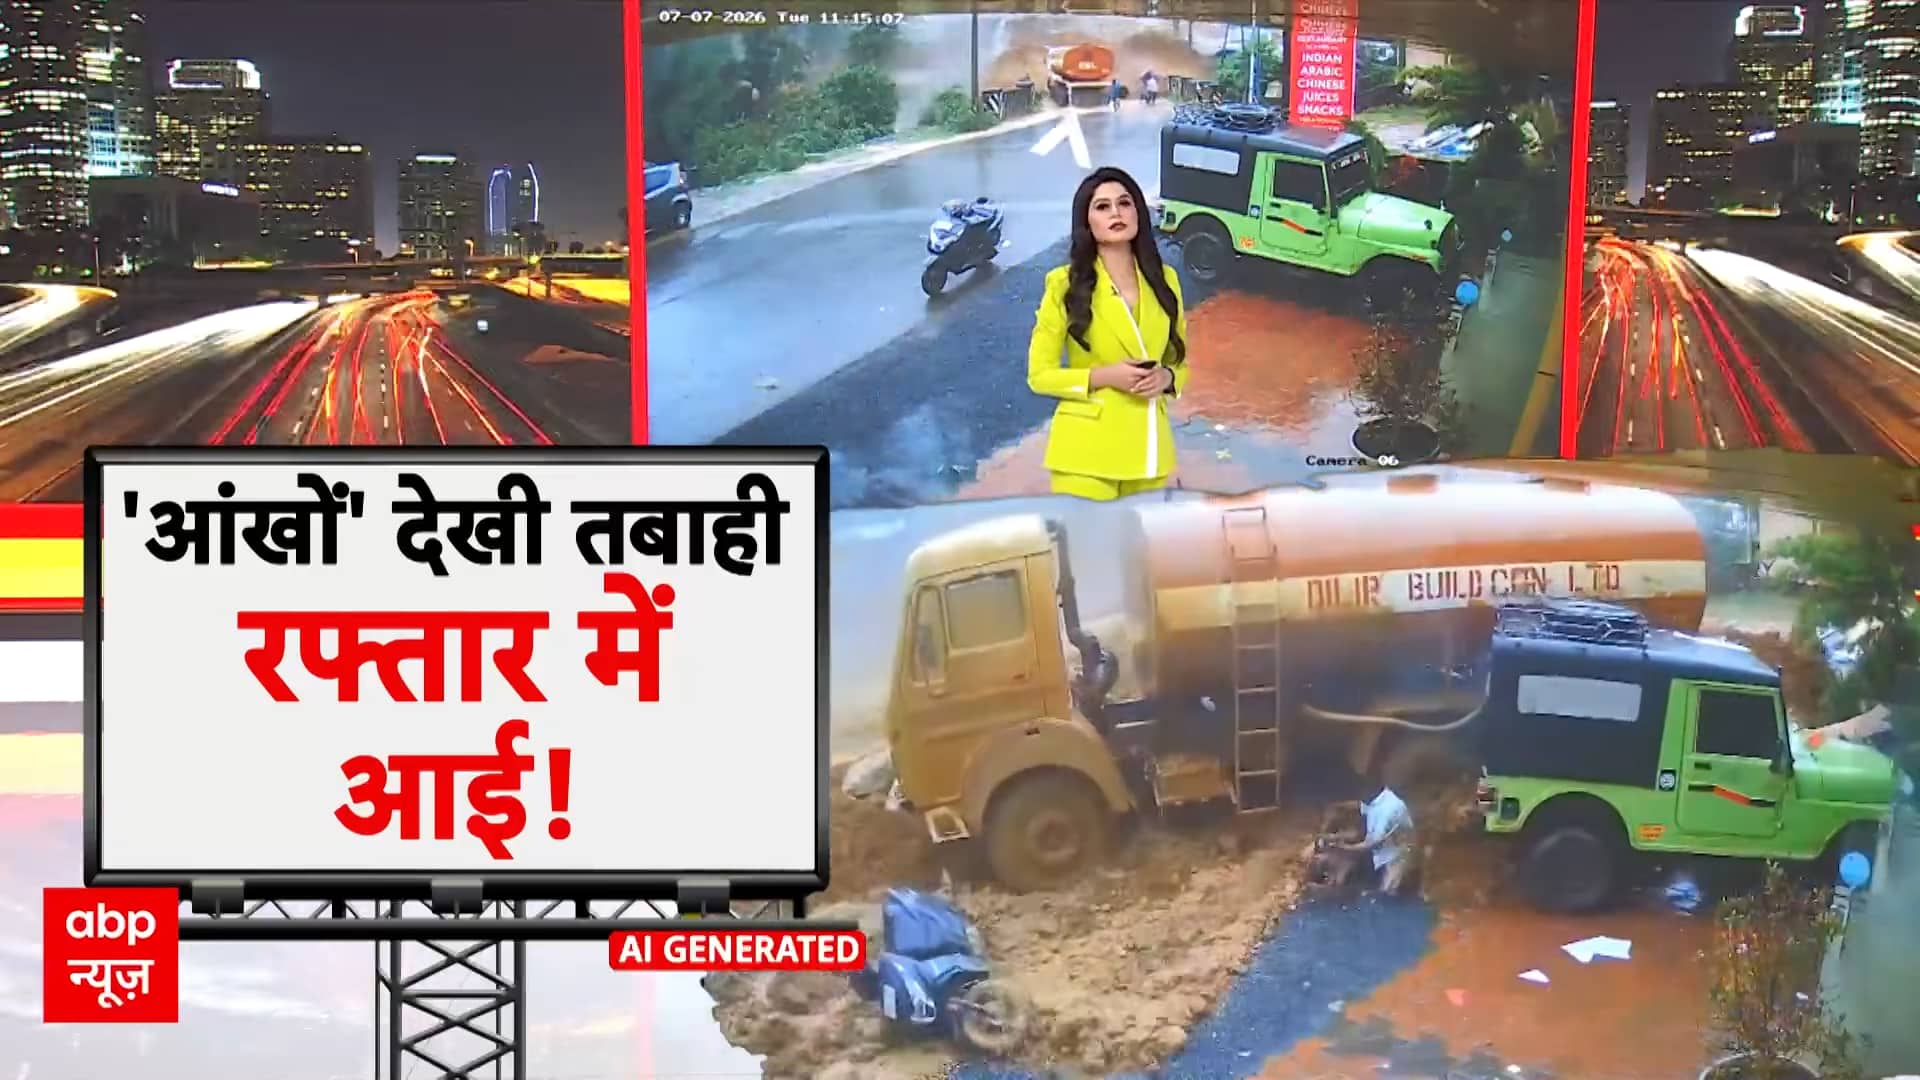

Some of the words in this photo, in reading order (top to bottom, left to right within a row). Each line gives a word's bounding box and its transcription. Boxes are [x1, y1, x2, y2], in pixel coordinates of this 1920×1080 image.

[1302, 52, 1343, 64] INDIAN
[1300, 65, 1343, 77] ARABIC
[1297, 78, 1345, 90] CHINESE
[1303, 91, 1339, 103] JUICES
[1297, 104, 1344, 116] SNACKS
[1568, 564, 1620, 592] LTD
